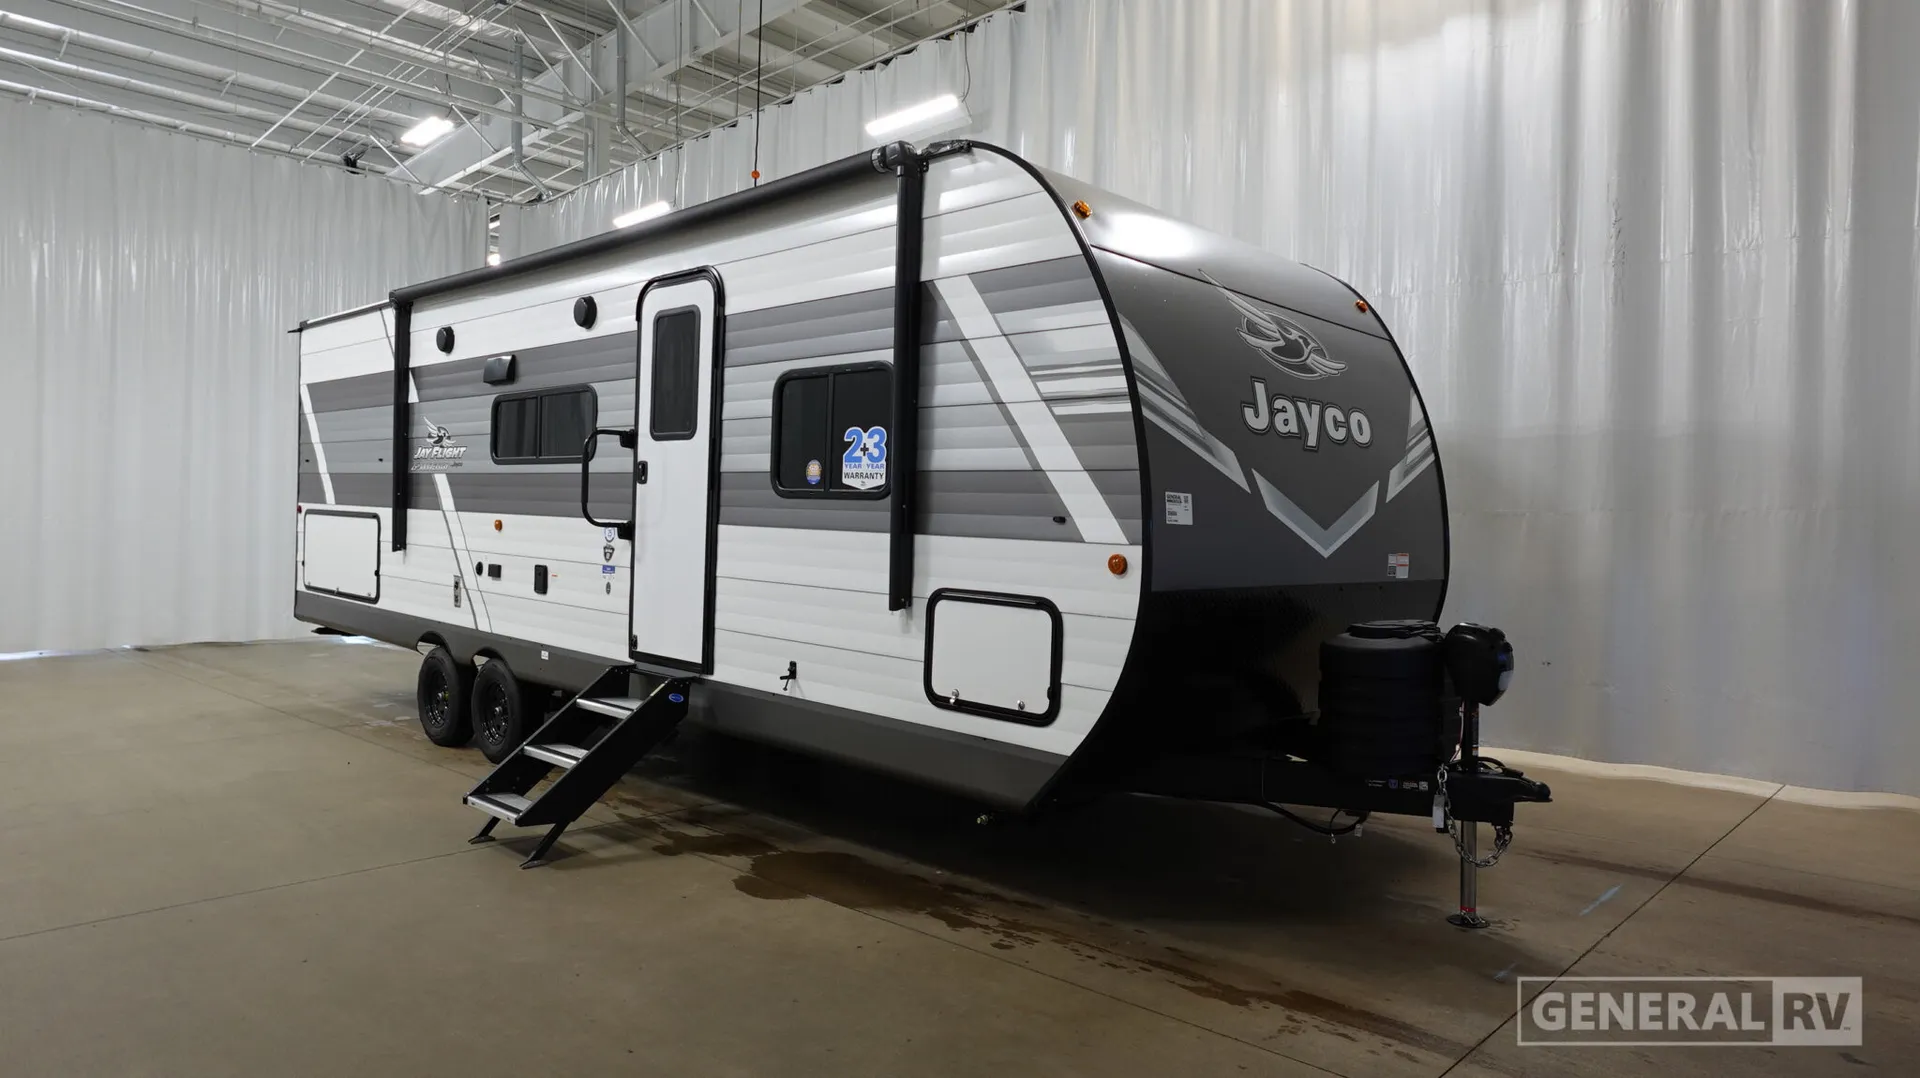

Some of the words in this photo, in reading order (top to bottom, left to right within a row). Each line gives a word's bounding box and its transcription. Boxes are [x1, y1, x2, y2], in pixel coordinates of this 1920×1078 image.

[1241, 376, 1373, 452] Jayco
[413, 446, 432, 460] JAY
[431, 446, 468, 460] FLIGHT
[844, 471, 884, 480] WARRANTY
